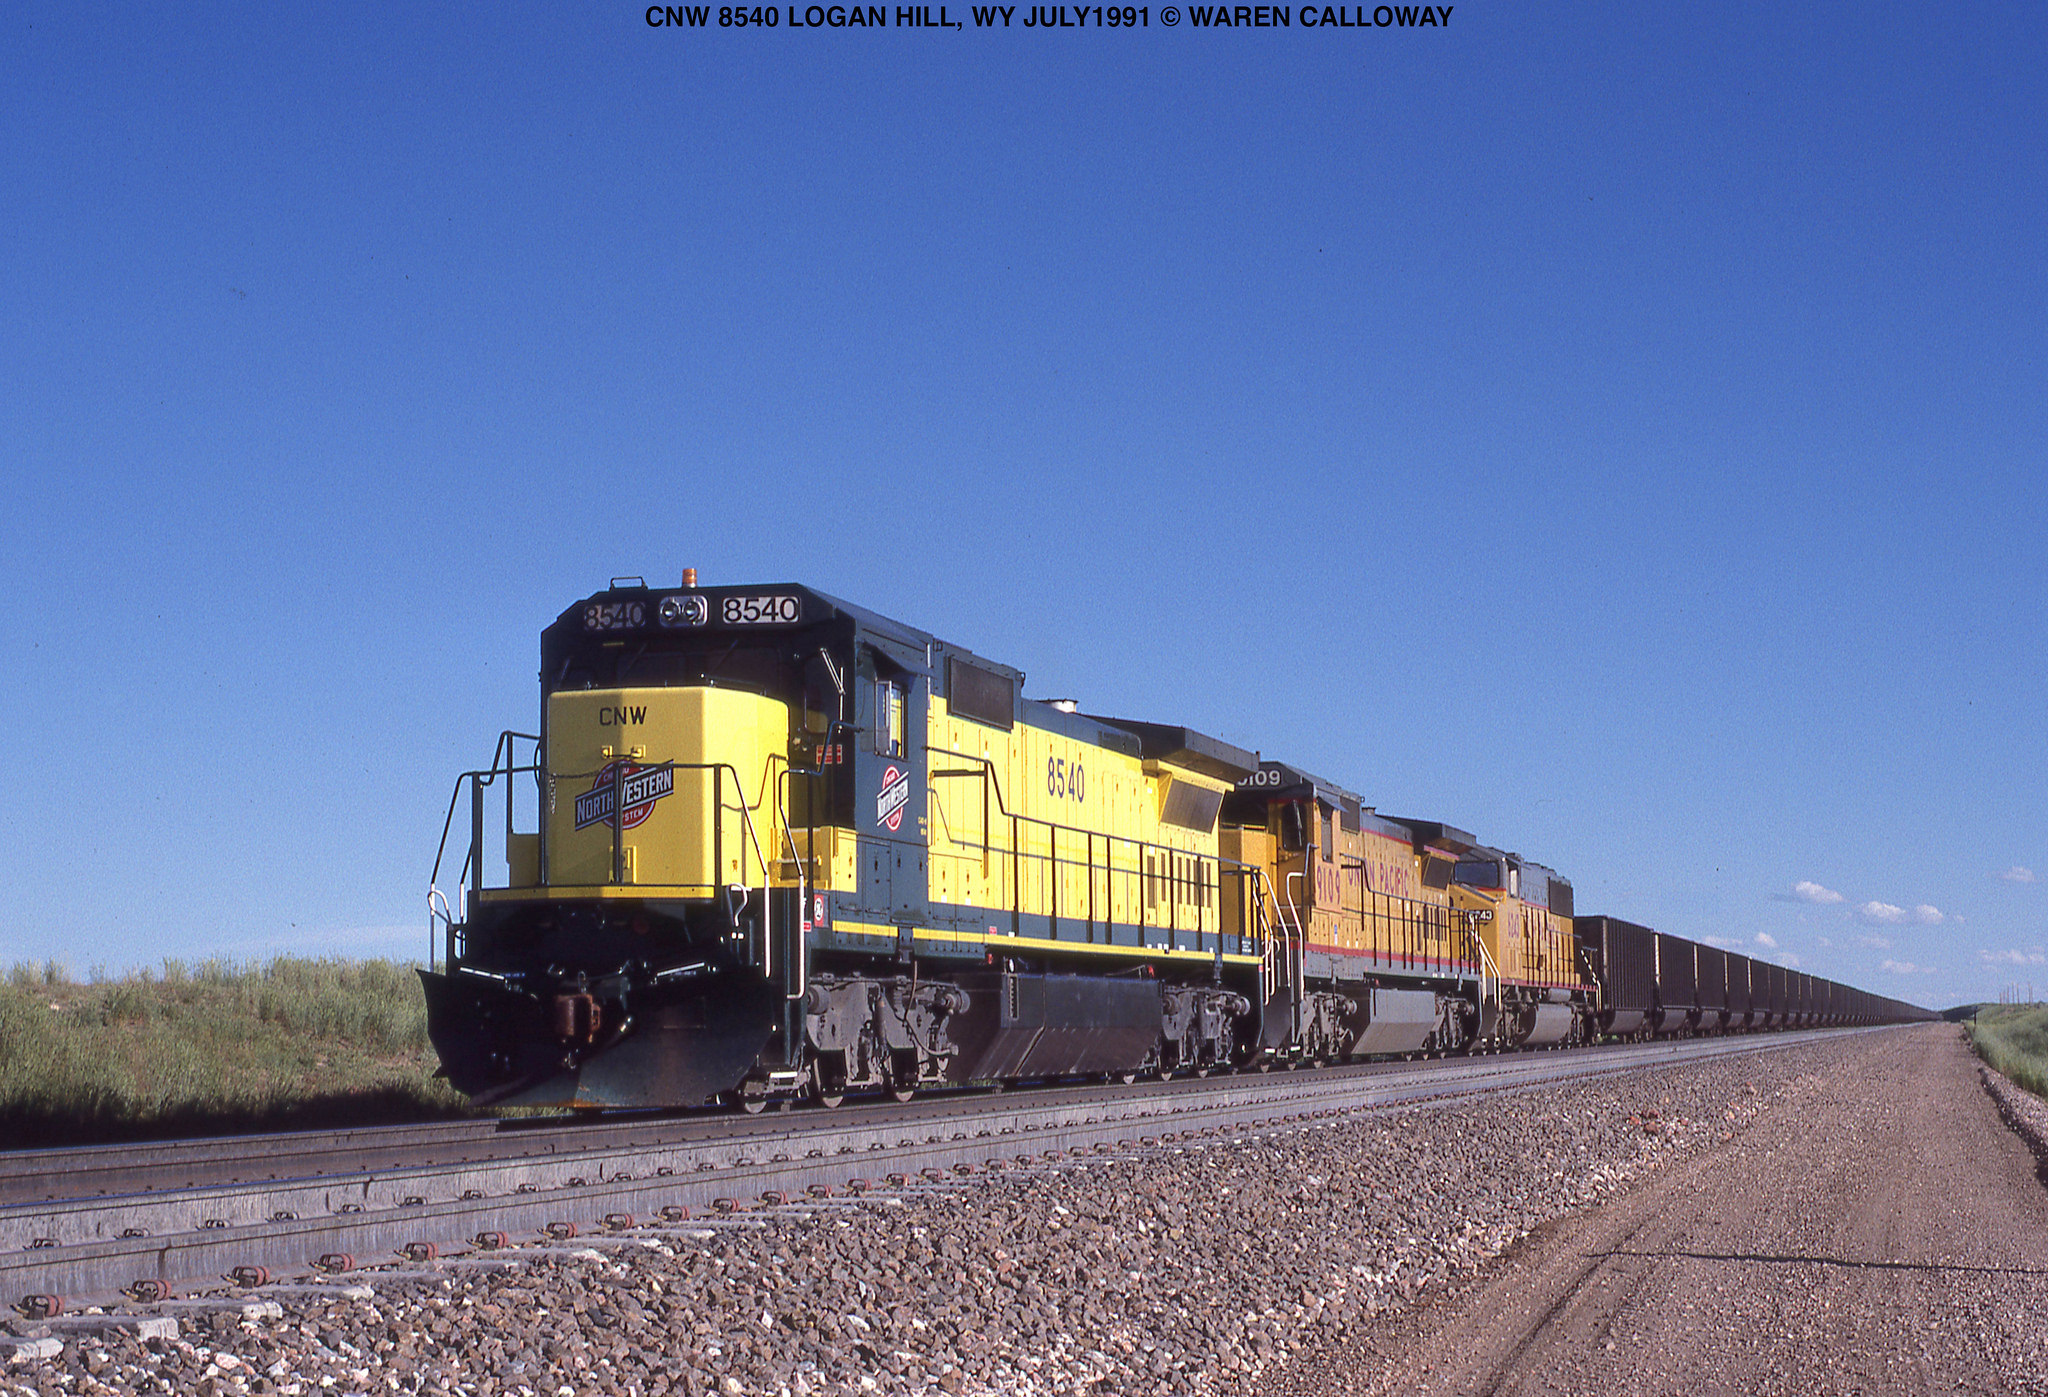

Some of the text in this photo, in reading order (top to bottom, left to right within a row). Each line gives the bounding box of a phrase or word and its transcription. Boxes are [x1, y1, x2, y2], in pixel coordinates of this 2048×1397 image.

[584, 602, 646, 629] 8540
[724, 598, 798, 622] 8540
[600, 706, 647, 726] CNW
[1048, 756, 1084, 803] 8540
[577, 790, 614, 823] NORTH
[1316, 865, 1340, 905] 9109
[1380, 862, 1409, 898] PACIFIC
